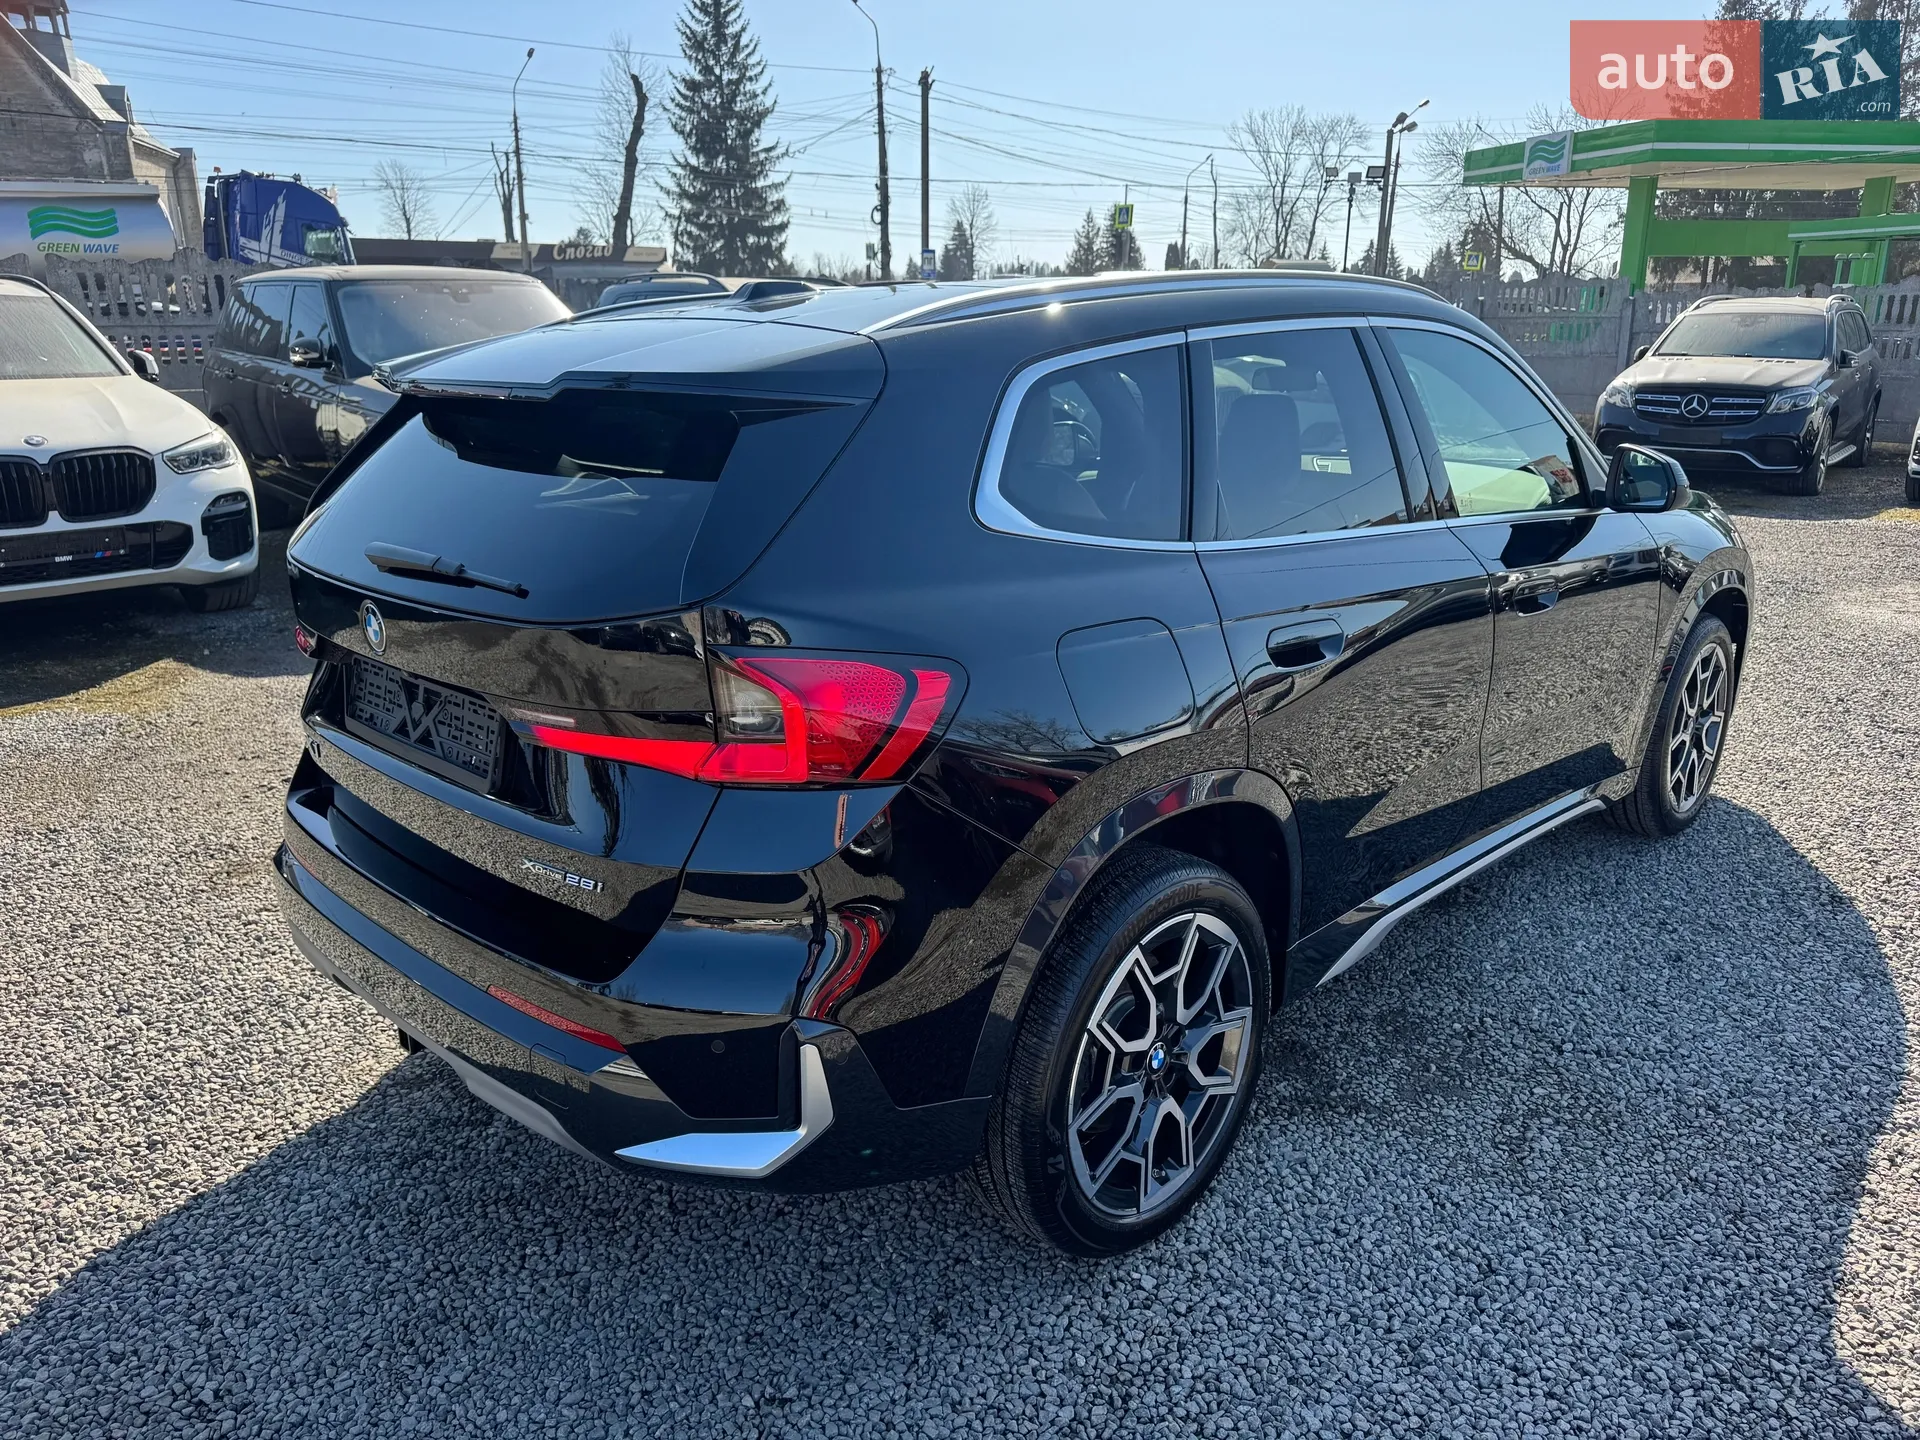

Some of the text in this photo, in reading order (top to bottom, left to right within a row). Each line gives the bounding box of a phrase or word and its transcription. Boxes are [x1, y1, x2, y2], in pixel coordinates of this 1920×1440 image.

[1528, 163, 1561, 176] GREEN WAVE
[37, 241, 120, 254] GREEN WAVE
[552, 242, 614, 261] Спогад
[54, 555, 73, 563] BMW
